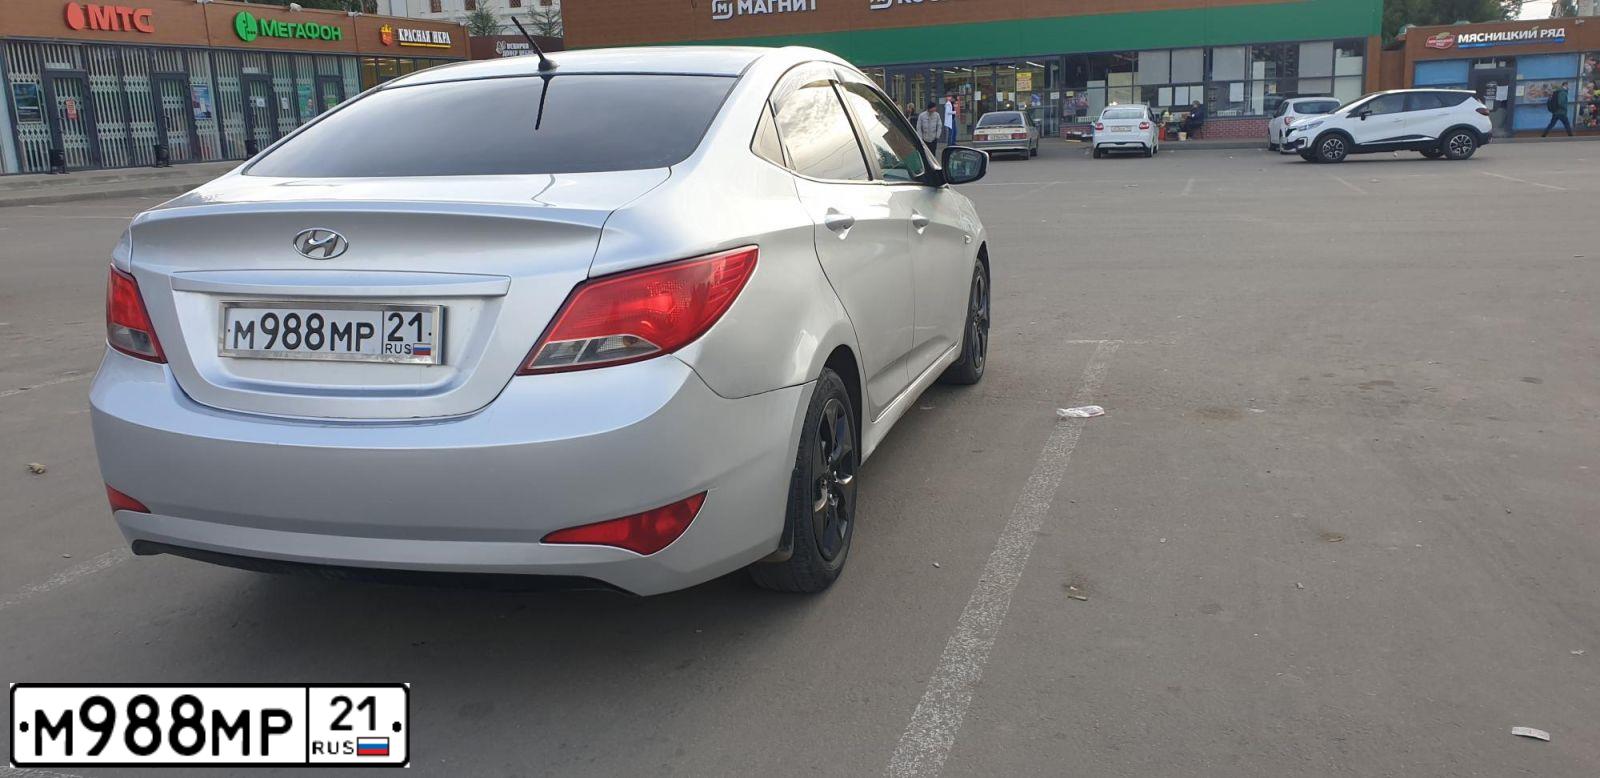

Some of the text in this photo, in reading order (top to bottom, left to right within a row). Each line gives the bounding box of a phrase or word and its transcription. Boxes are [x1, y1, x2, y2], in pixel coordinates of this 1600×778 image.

[88, 4, 154, 33] МТС
[398, 28, 451, 44] КРАСНАЯ ИКРА
[1457, 27, 1538, 43] МЯСНИЦКИЙ
[1540, 28, 1566, 38] РЯД
[233, 312, 375, 352] М988МР
[387, 312, 423, 342] 21
[385, 343, 412, 355] RUS
